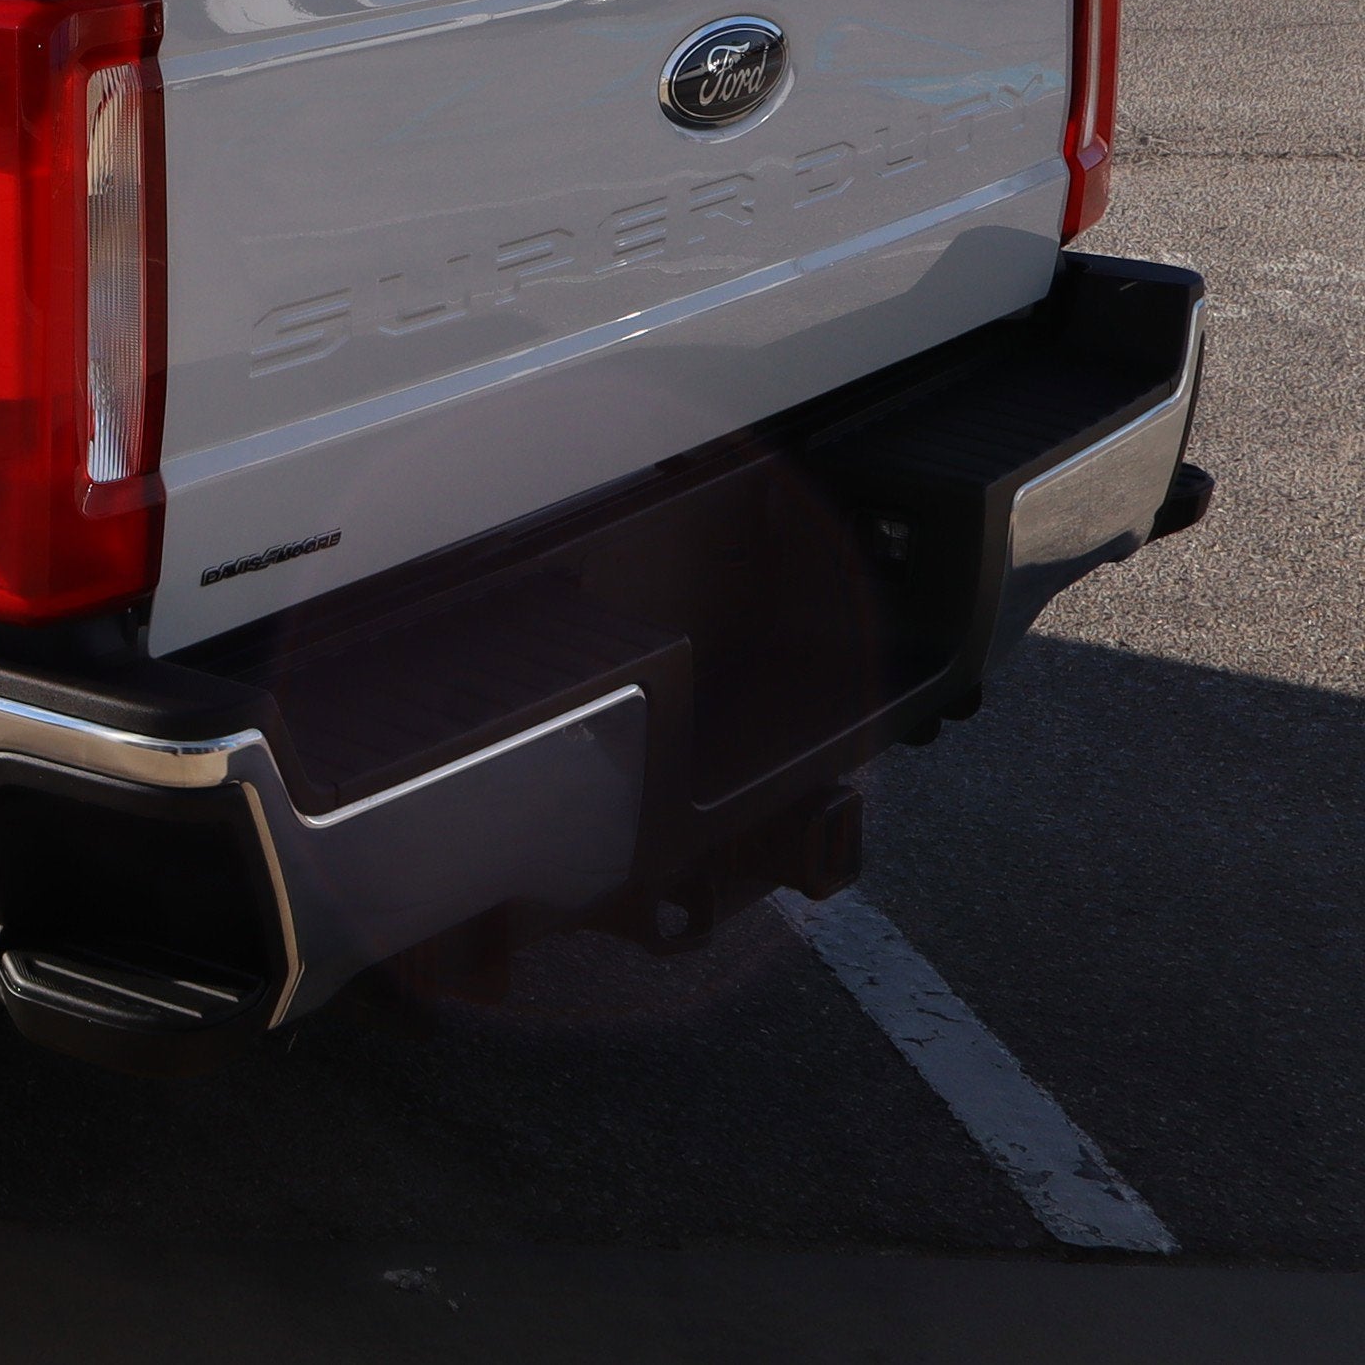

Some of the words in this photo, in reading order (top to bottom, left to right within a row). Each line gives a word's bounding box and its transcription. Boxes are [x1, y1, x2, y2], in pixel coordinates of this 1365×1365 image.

[698, 41, 770, 107] Ford
[248, 172, 757, 380] SUPER
[791, 73, 1045, 212] DUTY
